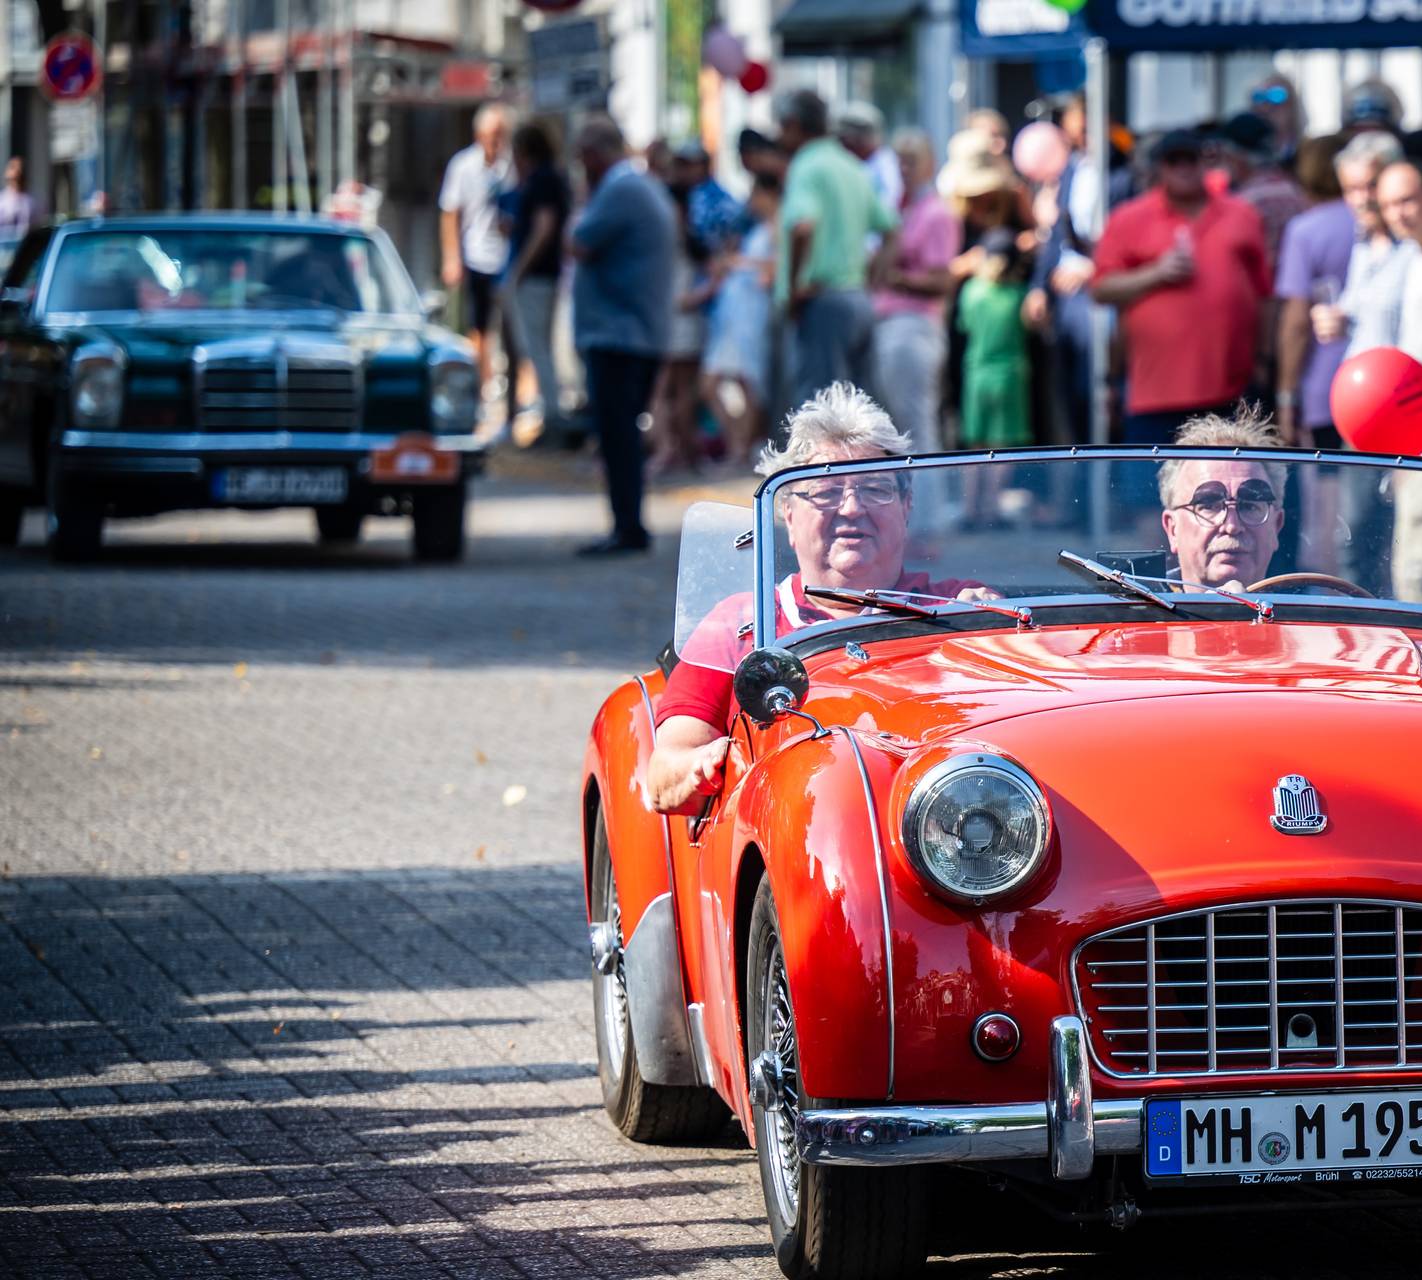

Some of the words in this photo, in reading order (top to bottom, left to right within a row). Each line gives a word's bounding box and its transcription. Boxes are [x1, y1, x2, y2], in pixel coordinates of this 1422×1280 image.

[1186, 1107, 1252, 1165] MH
[1295, 1103, 1326, 1160] M
[1159, 1146, 1171, 1161] D
[1239, 1173, 1261, 1184] TSC
[1263, 1172, 1303, 1184] Motorsport
[1315, 1171, 1339, 1181] Brühl
